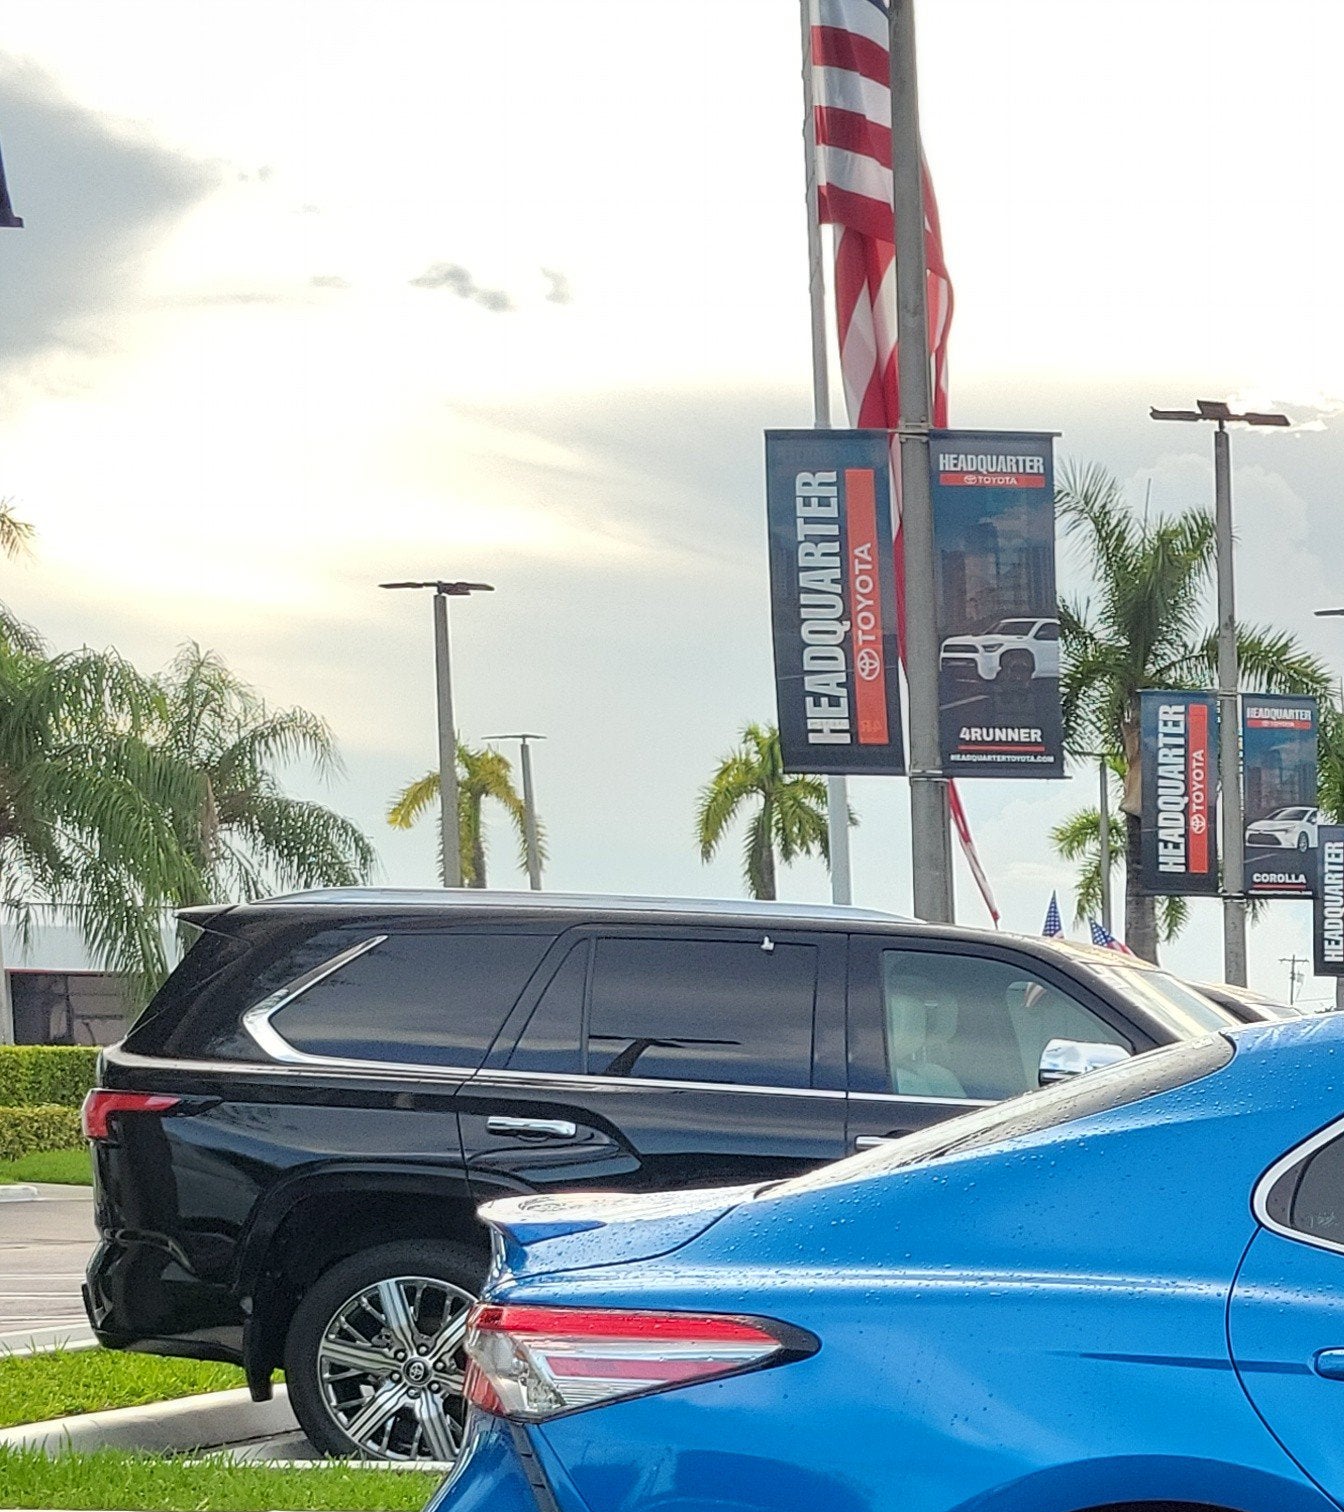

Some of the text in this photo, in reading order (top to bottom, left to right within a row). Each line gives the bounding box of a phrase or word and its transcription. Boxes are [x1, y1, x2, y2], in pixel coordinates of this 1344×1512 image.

[939, 453, 1045, 475] HEADQUARTER
[978, 476, 1018, 485] TOYOTA
[853, 542, 877, 645] TOYOTA
[795, 470, 852, 745] HEADQUARTER
[1246, 706, 1312, 720] HEADQUARTER
[959, 727, 1042, 742] 4RUNNER
[1157, 704, 1189, 872] HEADQUARTER
[1192, 749, 1205, 812] TOYOTA
[1252, 872, 1307, 884] COROLLA
